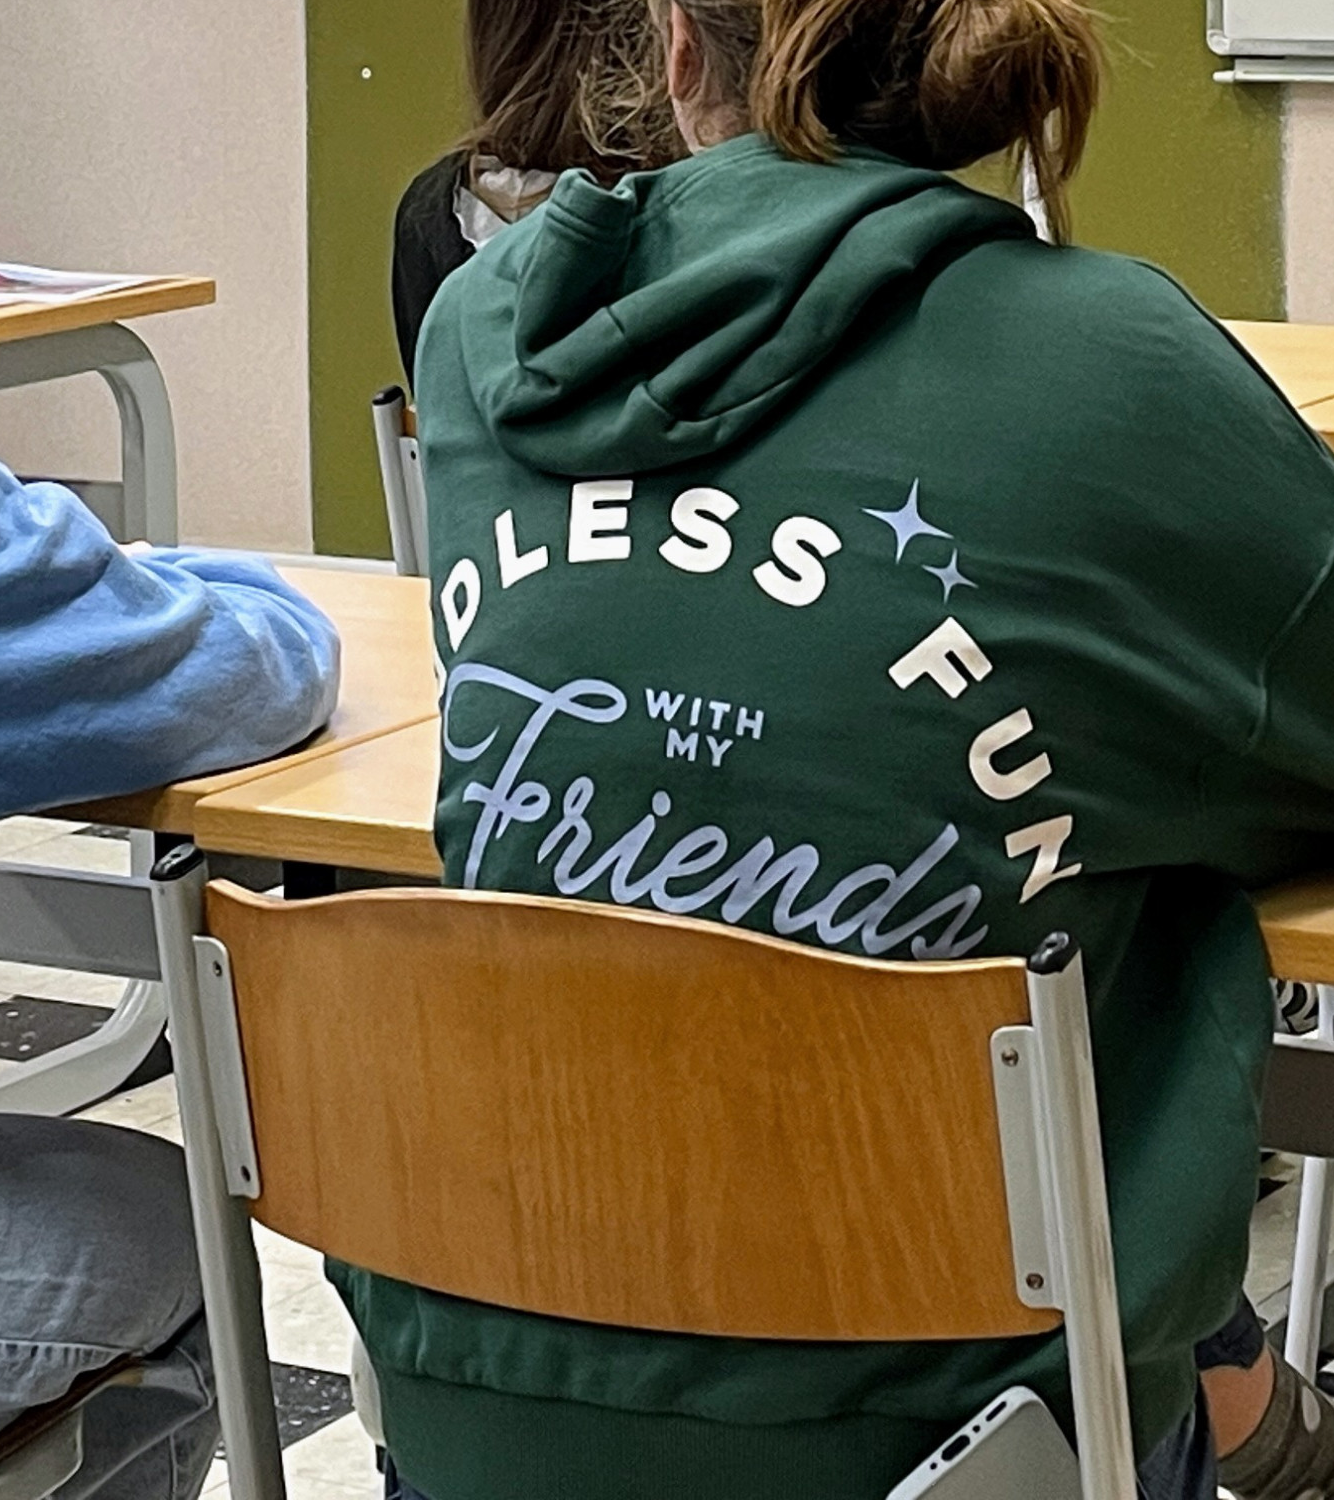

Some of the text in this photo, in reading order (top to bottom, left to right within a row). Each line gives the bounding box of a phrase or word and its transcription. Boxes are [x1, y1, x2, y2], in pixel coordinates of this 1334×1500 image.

[645, 687, 765, 740] WITH
[666, 727, 734, 767] MY
[888, 615, 1082, 905] FUN
[442, 662, 989, 960] Friends
